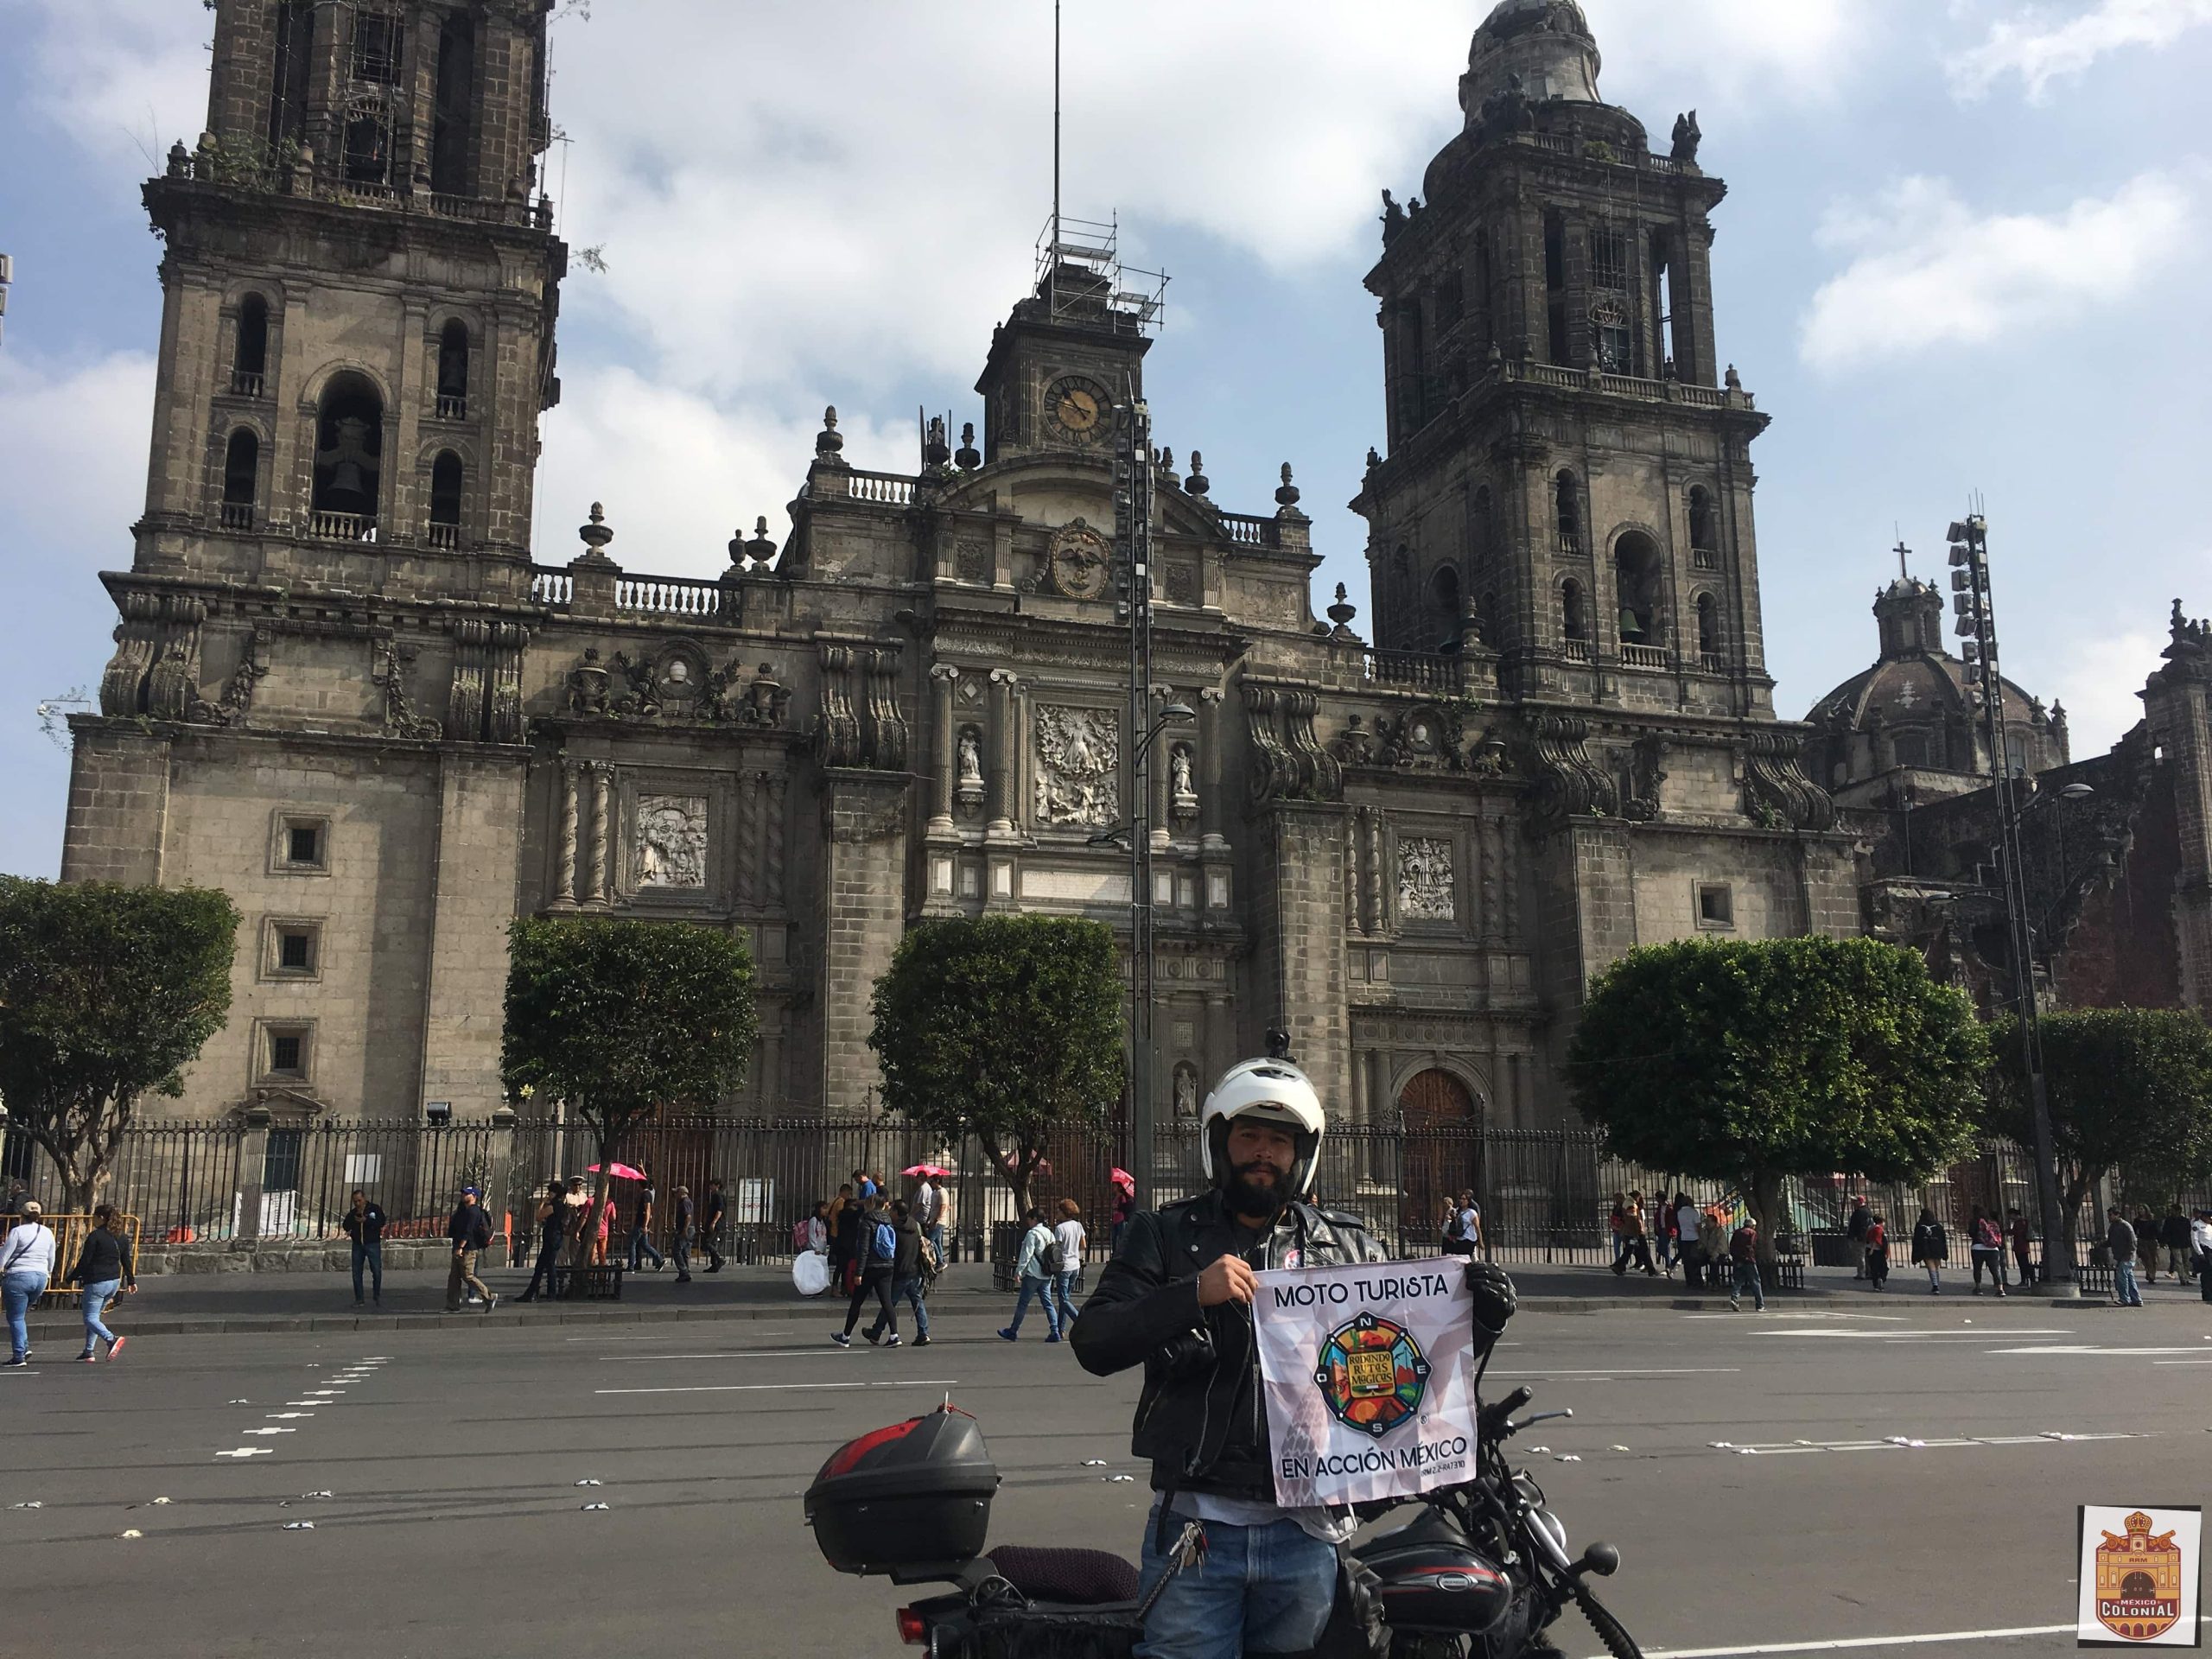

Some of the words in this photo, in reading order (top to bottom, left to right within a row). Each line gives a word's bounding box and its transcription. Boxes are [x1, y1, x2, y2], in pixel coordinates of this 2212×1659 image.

[1274, 1282, 1349, 1307] MOTO
[1354, 1274, 1449, 1302] TURISTA
[1360, 1318, 1372, 1326] N
[1417, 1365, 1427, 1375] E
[1317, 1373, 1328, 1382] O
[1372, 1423, 1383, 1433] S
[1281, 1457, 1310, 1478] EN
[1314, 1446, 1396, 1478] ACCIÓN
[1400, 1436, 1468, 1469] MÉXICO
